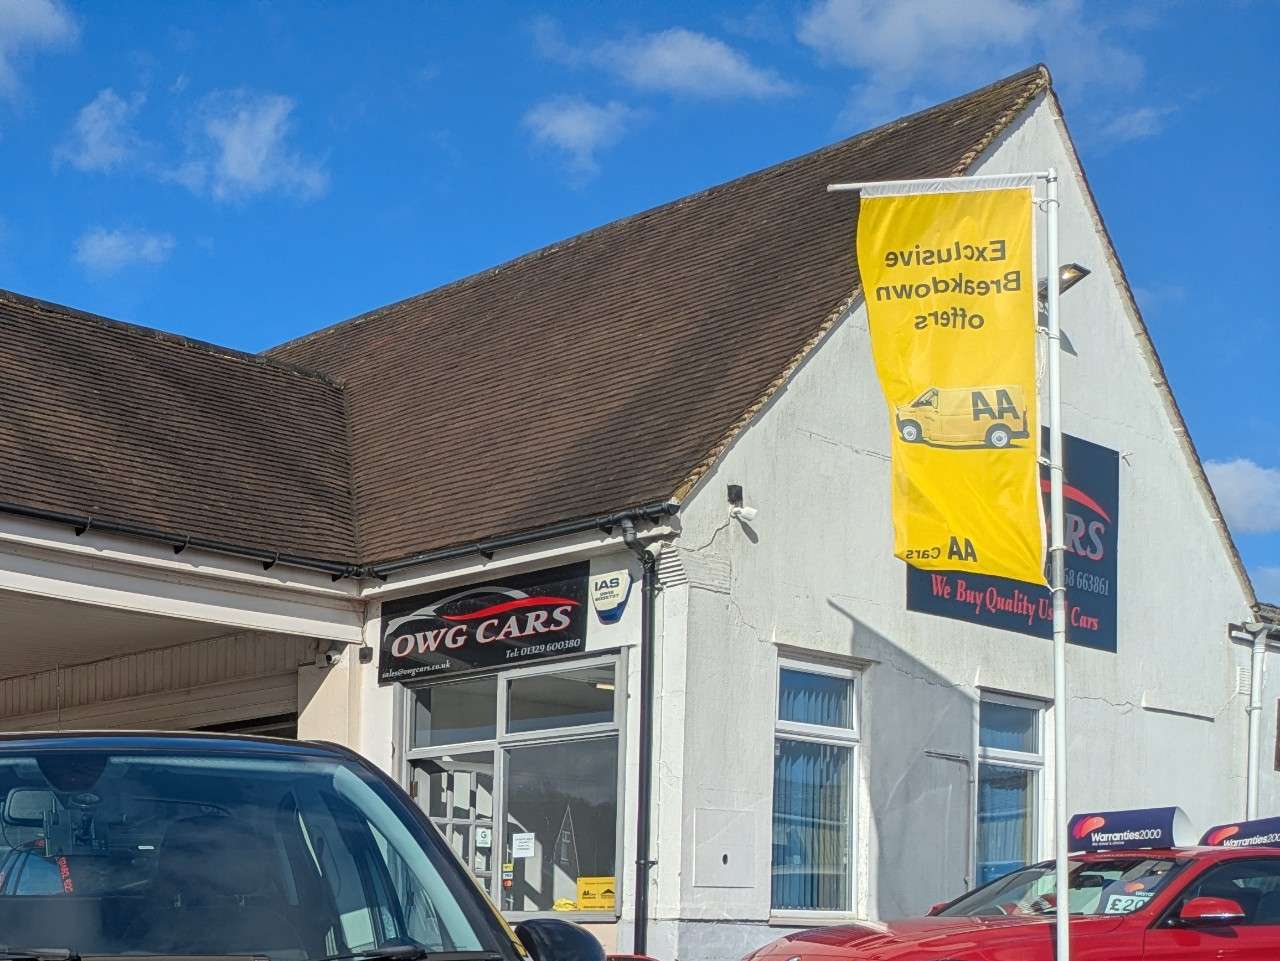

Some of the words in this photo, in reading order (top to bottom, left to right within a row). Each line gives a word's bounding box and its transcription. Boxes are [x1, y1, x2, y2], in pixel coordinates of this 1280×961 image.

[1076, 571, 1110, 596] 663861
[930, 574, 951, 599] We
[956, 579, 983, 615] Buy
[985, 587, 1036, 626] Quality
[1038, 598, 1067, 621] Us
[1070, 607, 1099, 631] Cars
[391, 624, 469, 658] OWG
[475, 605, 573, 645] CARS
[505, 648, 520, 659] Tel:
[520, 644, 545, 656] 01329
[1091, 828, 1162, 842] Warranties2000
